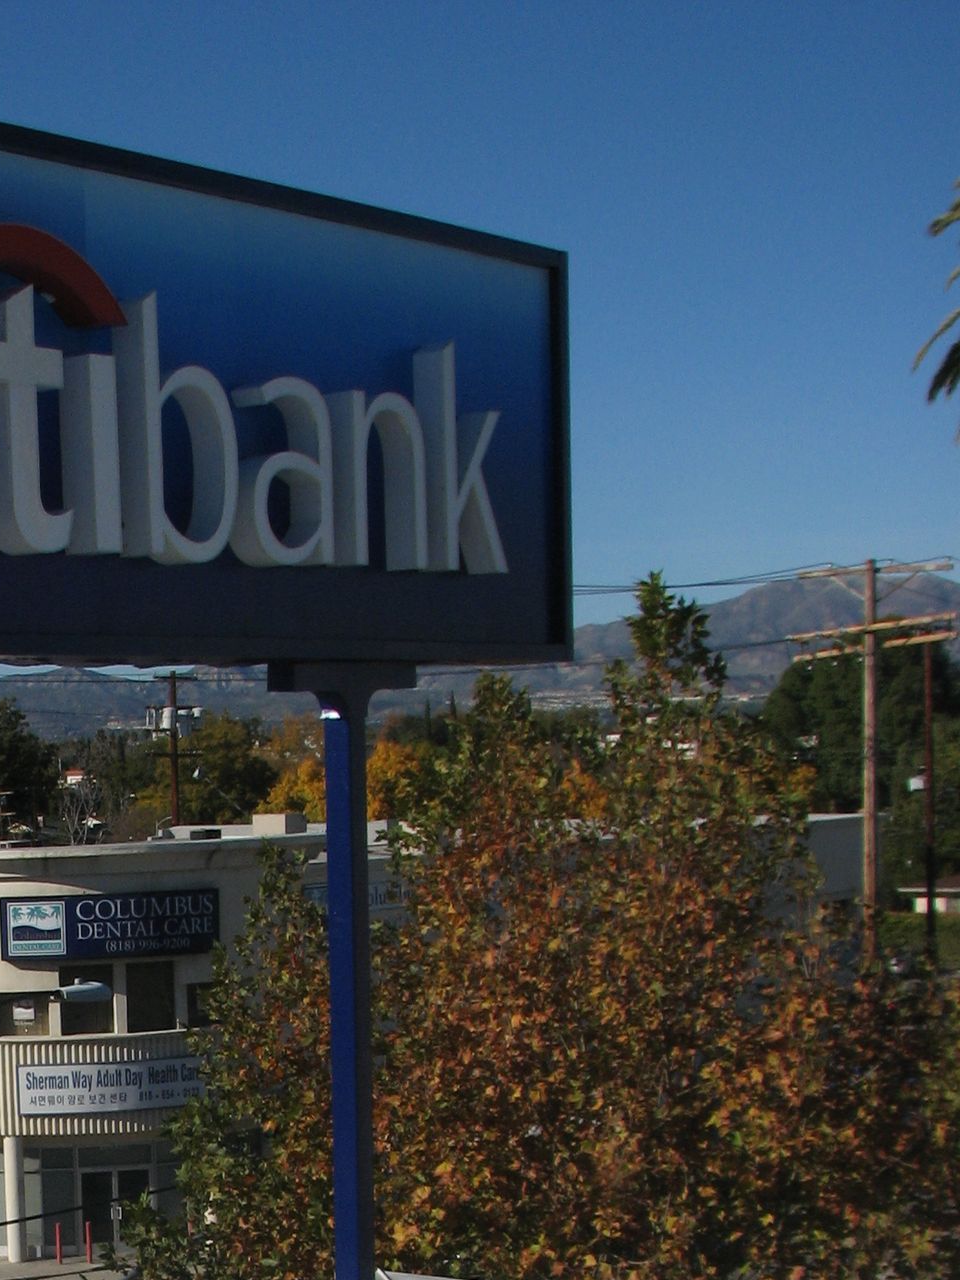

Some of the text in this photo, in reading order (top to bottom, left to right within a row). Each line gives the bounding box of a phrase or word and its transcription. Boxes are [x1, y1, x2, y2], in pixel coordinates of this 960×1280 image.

[76, 895, 214, 920] COLUMBUS
[77, 917, 214, 940] DENTAL CARE
[105, 940, 136, 952] (818)
[26, 1072, 69, 1090] Sherman
[71, 1071, 92, 1092] Way
[96, 1069, 122, 1088] Adult
[125, 1068, 143, 1089] Day
[148, 1064, 178, 1084] Health
